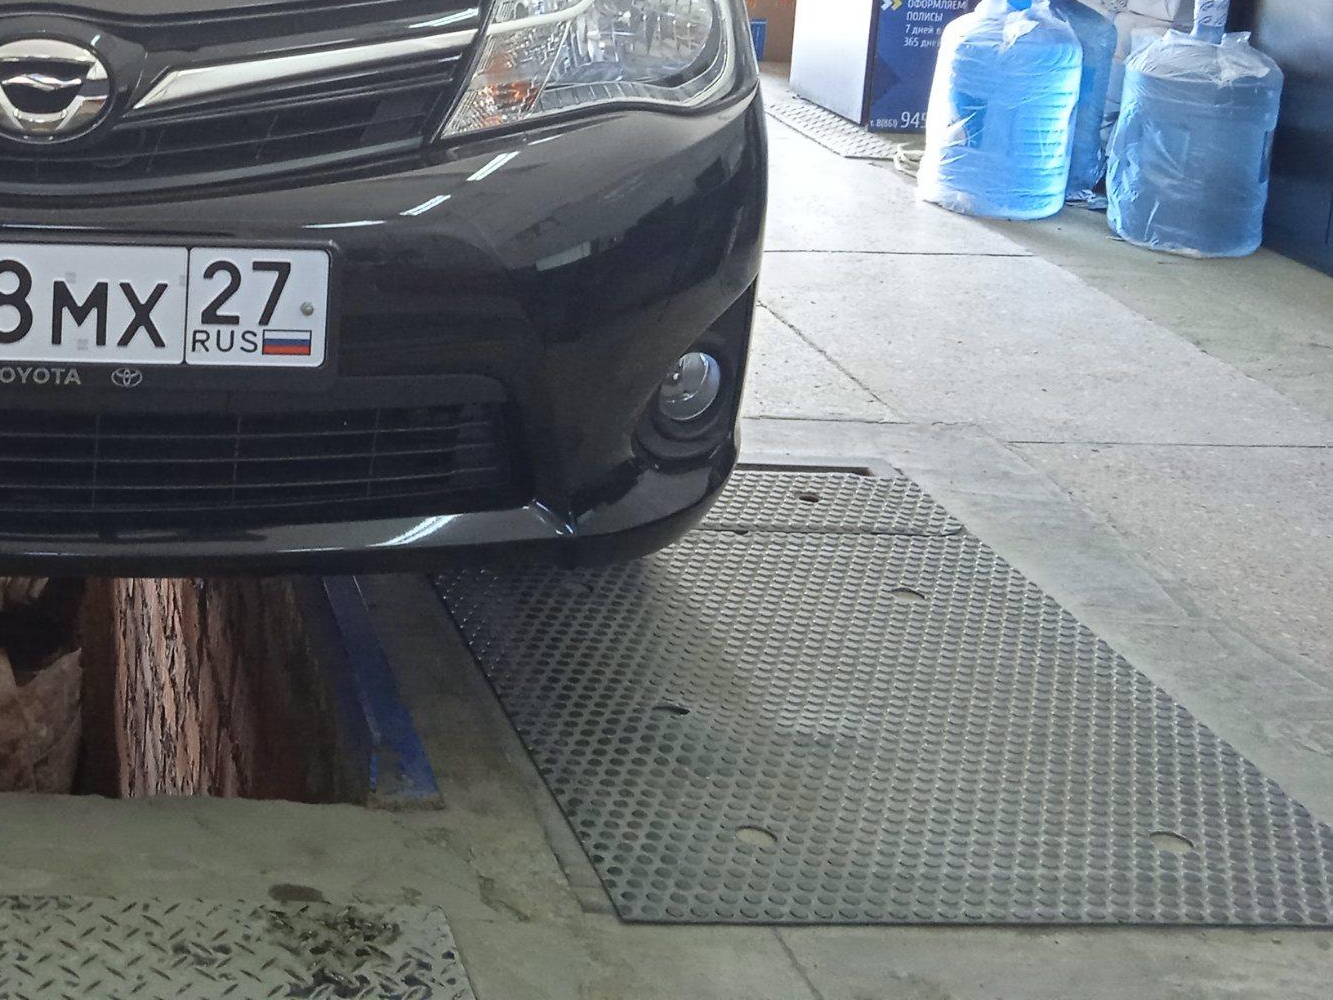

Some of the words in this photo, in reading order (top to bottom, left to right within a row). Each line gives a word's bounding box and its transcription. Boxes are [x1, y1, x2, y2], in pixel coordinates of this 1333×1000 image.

[906, 11, 944, 22] ПОЛИСЫ
[911, 25, 934, 35] дней
[903, 37, 919, 47] 365
[201, 260, 292, 326] 27
[191, 329, 258, 354] RUS
